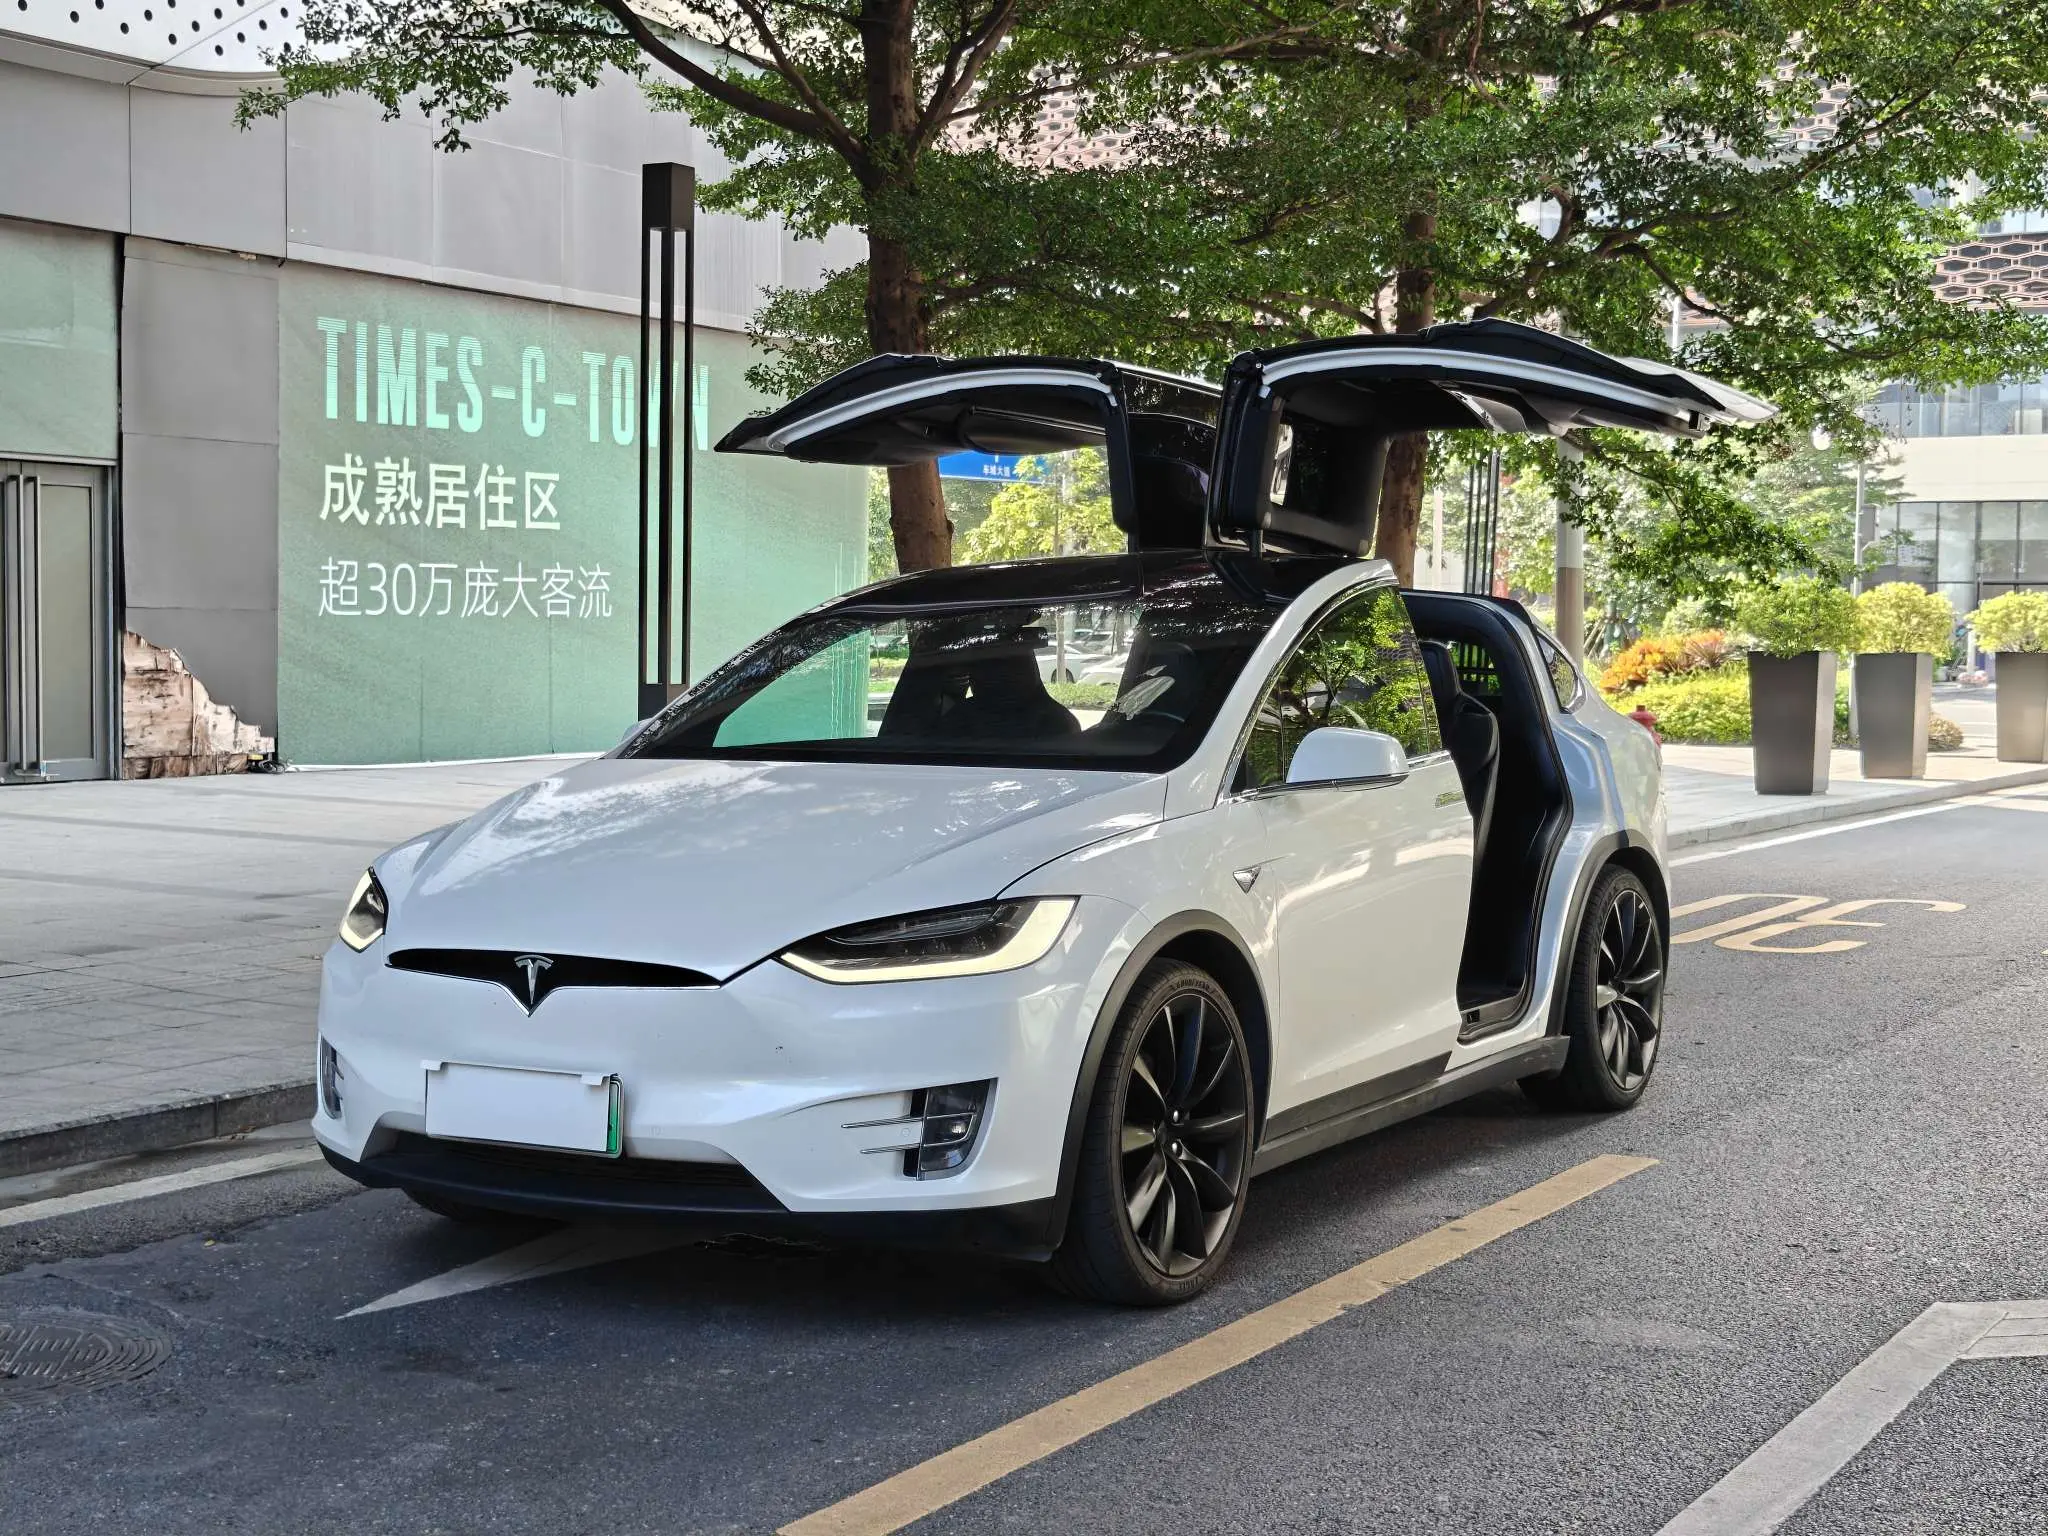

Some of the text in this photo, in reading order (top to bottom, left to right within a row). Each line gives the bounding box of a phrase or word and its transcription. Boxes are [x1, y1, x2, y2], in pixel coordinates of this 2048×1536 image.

[319, 453, 561, 530] 成熟居住区
[318, 556, 613, 618] 超30万庞大客流
